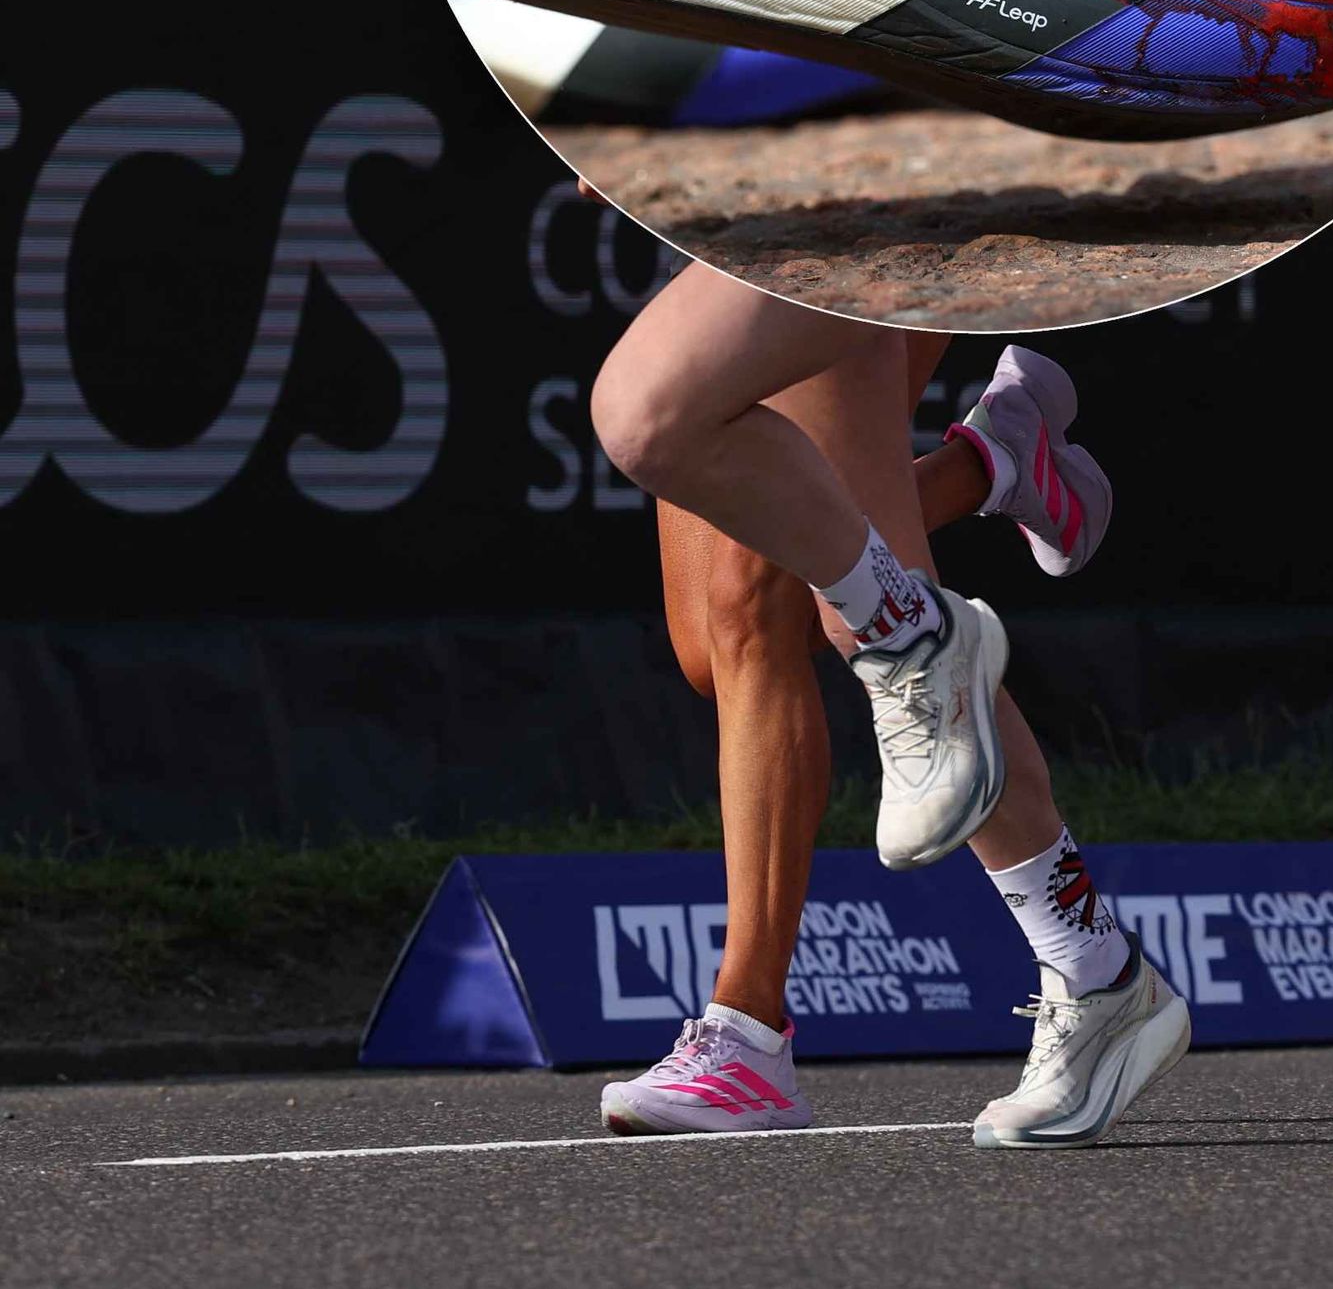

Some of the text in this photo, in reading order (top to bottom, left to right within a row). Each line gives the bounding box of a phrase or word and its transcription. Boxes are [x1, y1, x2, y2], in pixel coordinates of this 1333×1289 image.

[0, 88, 450, 514] cs
[798, 900, 896, 937] NDON
[784, 976, 910, 1015] EVENTS
